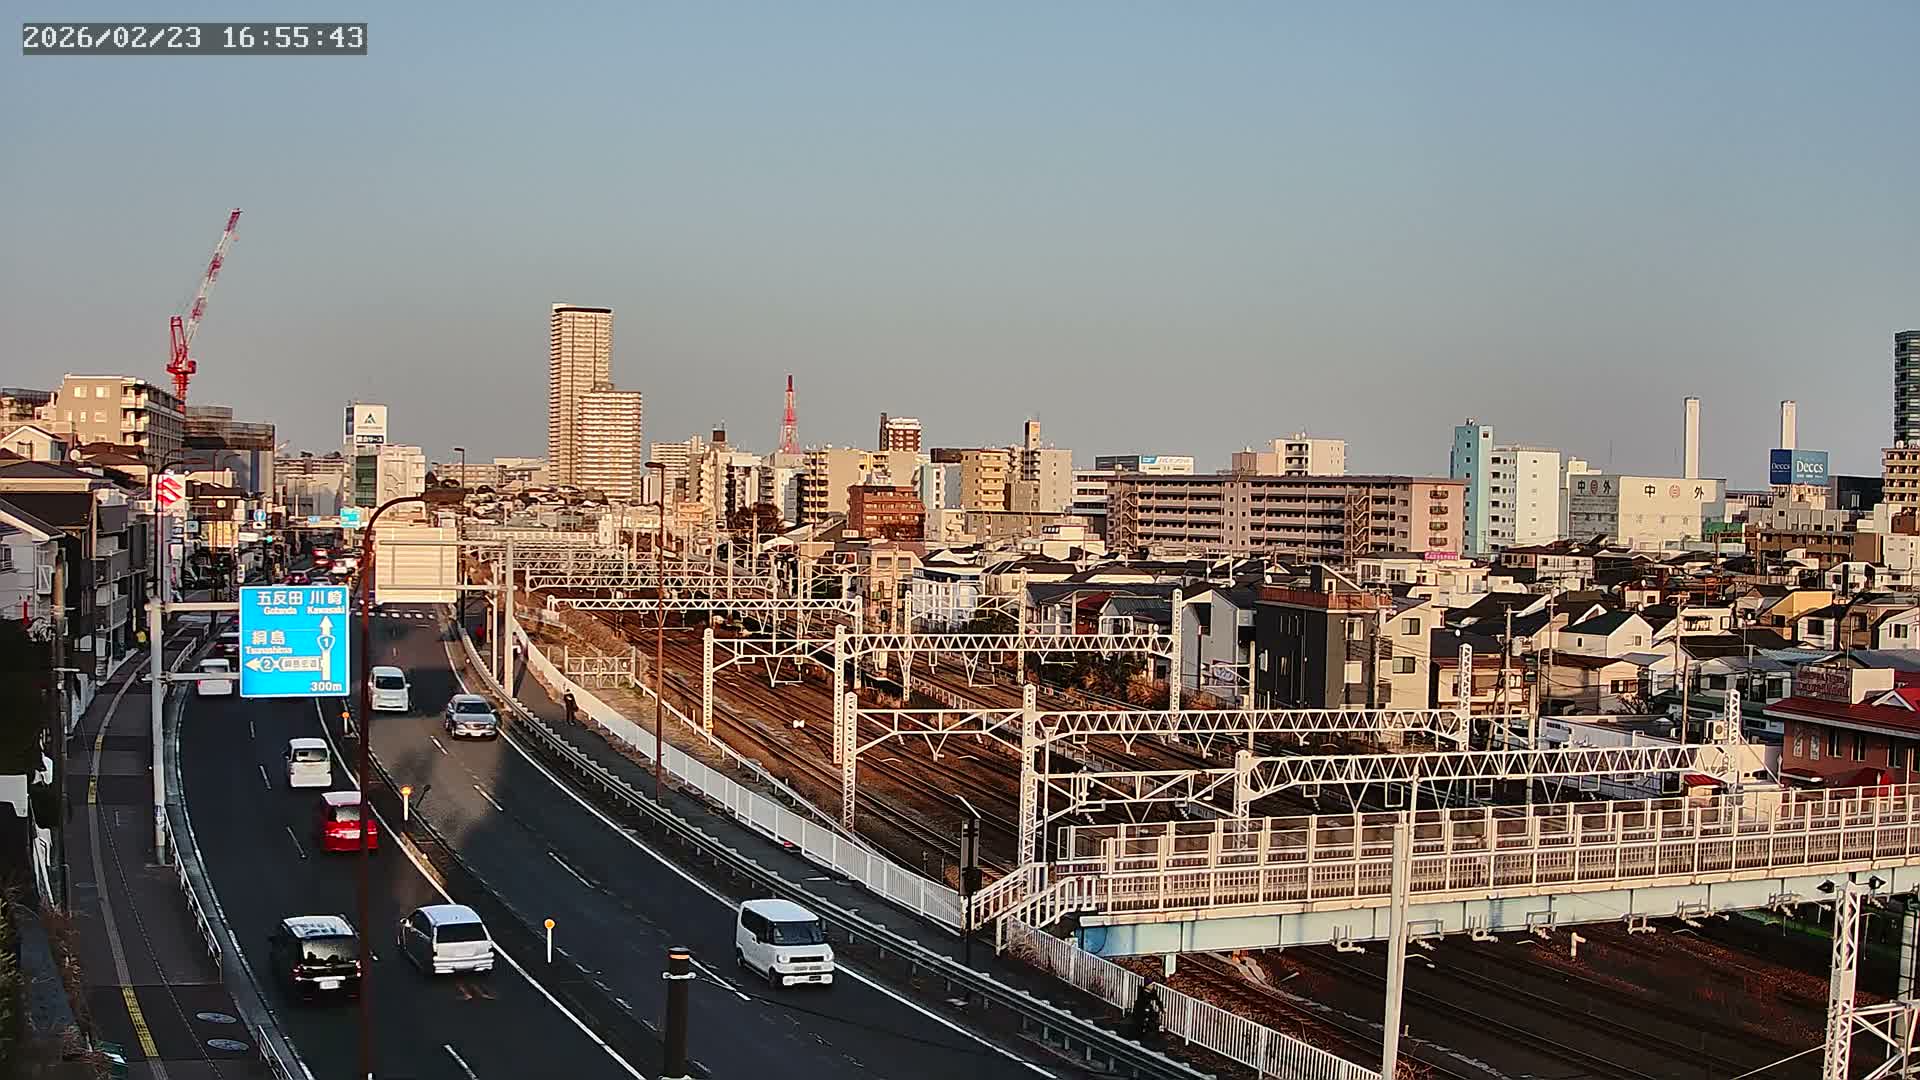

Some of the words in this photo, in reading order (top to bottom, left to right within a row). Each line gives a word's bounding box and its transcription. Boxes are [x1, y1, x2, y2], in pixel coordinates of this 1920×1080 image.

[1771, 462, 1790, 470] Deccs
[1796, 460, 1824, 473] Deccs
[257, 590, 303, 606] 五反田
[309, 590, 342, 605] 川崎
[323, 638, 329, 647] 1
[264, 660, 271, 668] 2
[311, 681, 342, 692] 300m
